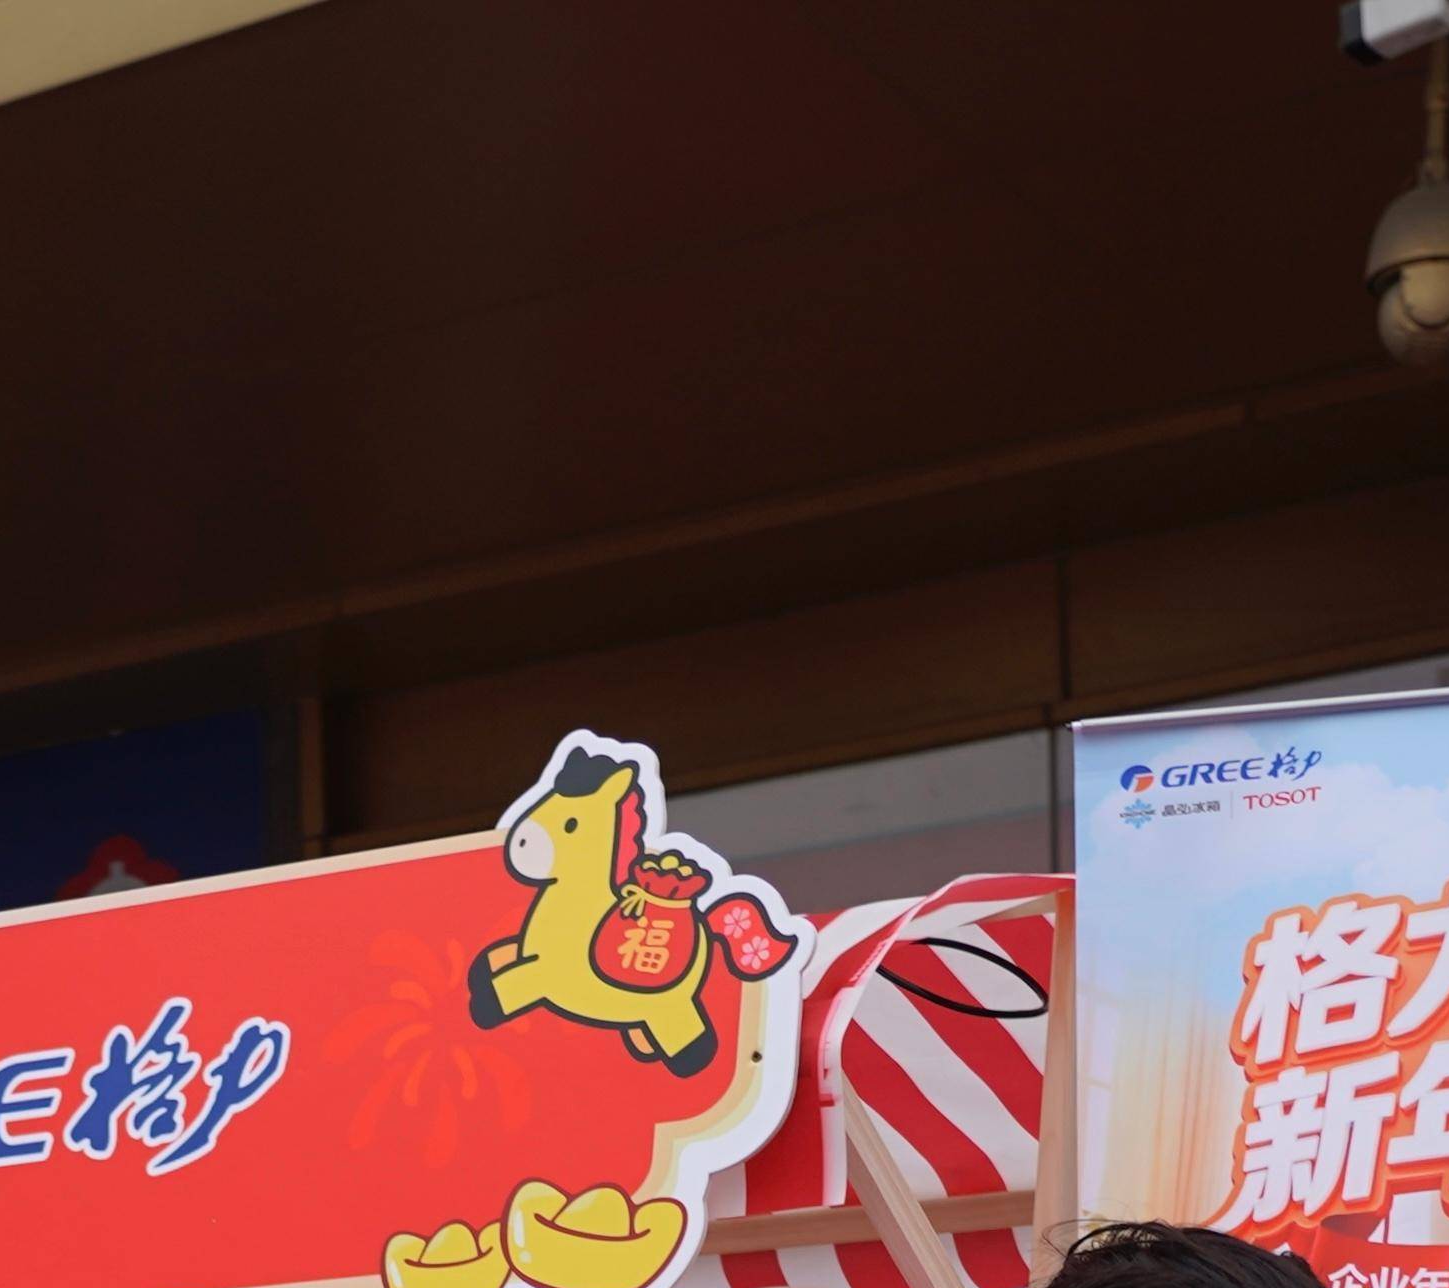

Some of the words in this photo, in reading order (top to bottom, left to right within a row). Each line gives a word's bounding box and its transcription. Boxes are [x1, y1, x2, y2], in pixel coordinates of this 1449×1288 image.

[1161, 756, 1265, 789] GREE
[1243, 786, 1323, 811] TOSOT
[617, 917, 675, 976] 福
